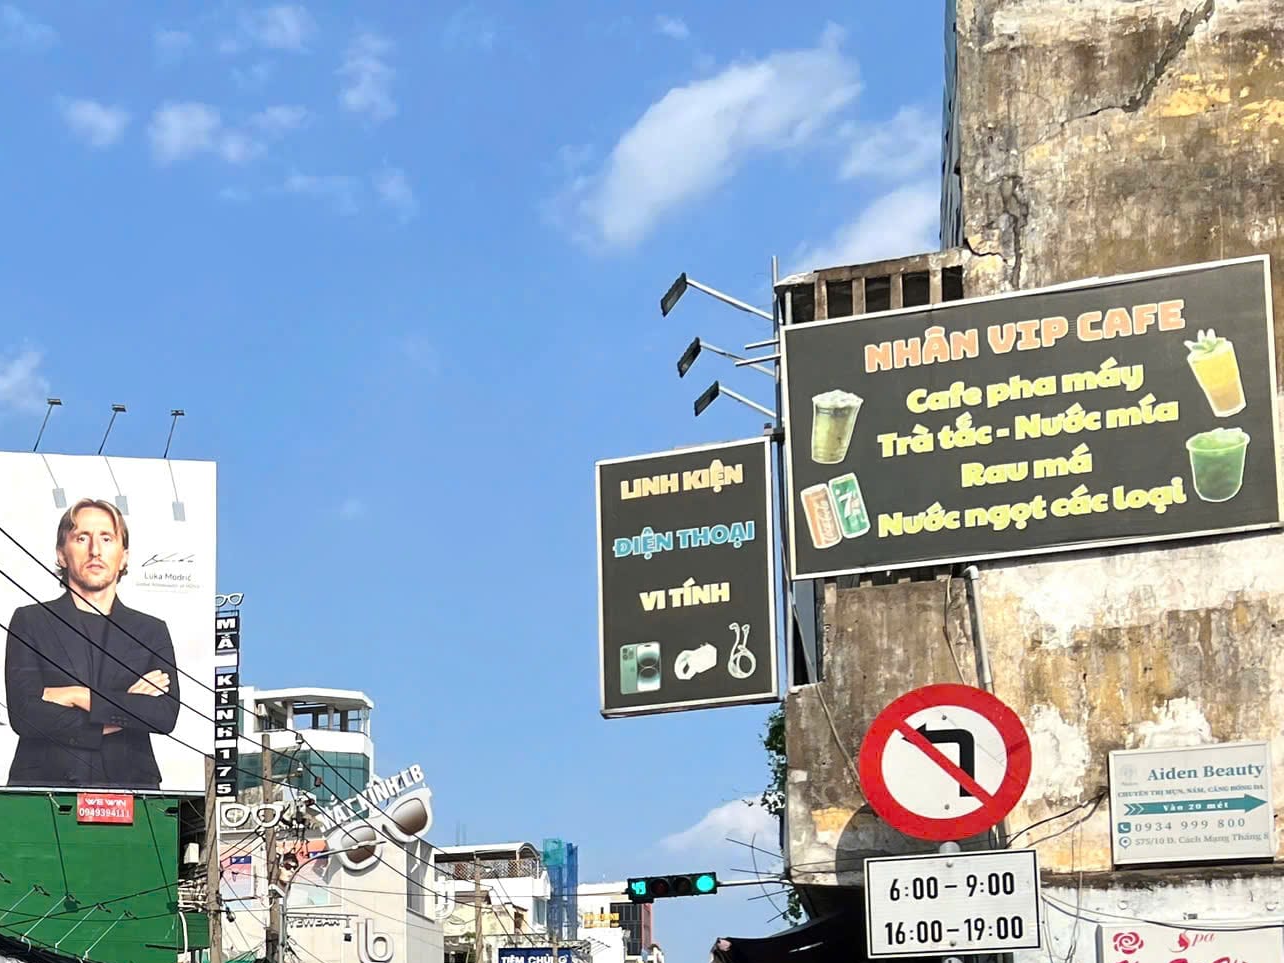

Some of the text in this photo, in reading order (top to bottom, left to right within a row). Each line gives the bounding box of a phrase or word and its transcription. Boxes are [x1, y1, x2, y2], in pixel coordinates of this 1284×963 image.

[865, 299, 1186, 373] NHÂN VIP CAFE
[906, 356, 1144, 414] Cafe pha máy
[877, 424, 934, 458] Trà
[938, 411, 993, 450] tắc
[1014, 402, 1102, 440] Nước
[1106, 392, 1180, 428] mía
[620, 459, 744, 500] LINH KIỆN
[961, 442, 1093, 488] Rau má
[878, 502, 961, 538] Nước
[965, 495, 1047, 531] ngọt
[1050, 484, 1109, 518] các
[1112, 476, 1188, 515] loại
[612, 520, 755, 560] ĐIỆN THOẠI
[144, 572, 163, 580] Luka
[639, 577, 731, 612] VI TÍNH
[216, 749, 232, 794] 175
[1147, 763, 1264, 781] Aiden Beauty
[1135, 818, 1245, 832] 0934 999 800
[1178, 834, 1202, 844] Cách
[1203, 833, 1230, 843] Mạng
[1232, 831, 1262, 842] Tháng
[890, 876, 938, 901] 6:00
[966, 872, 1014, 897] 9:00
